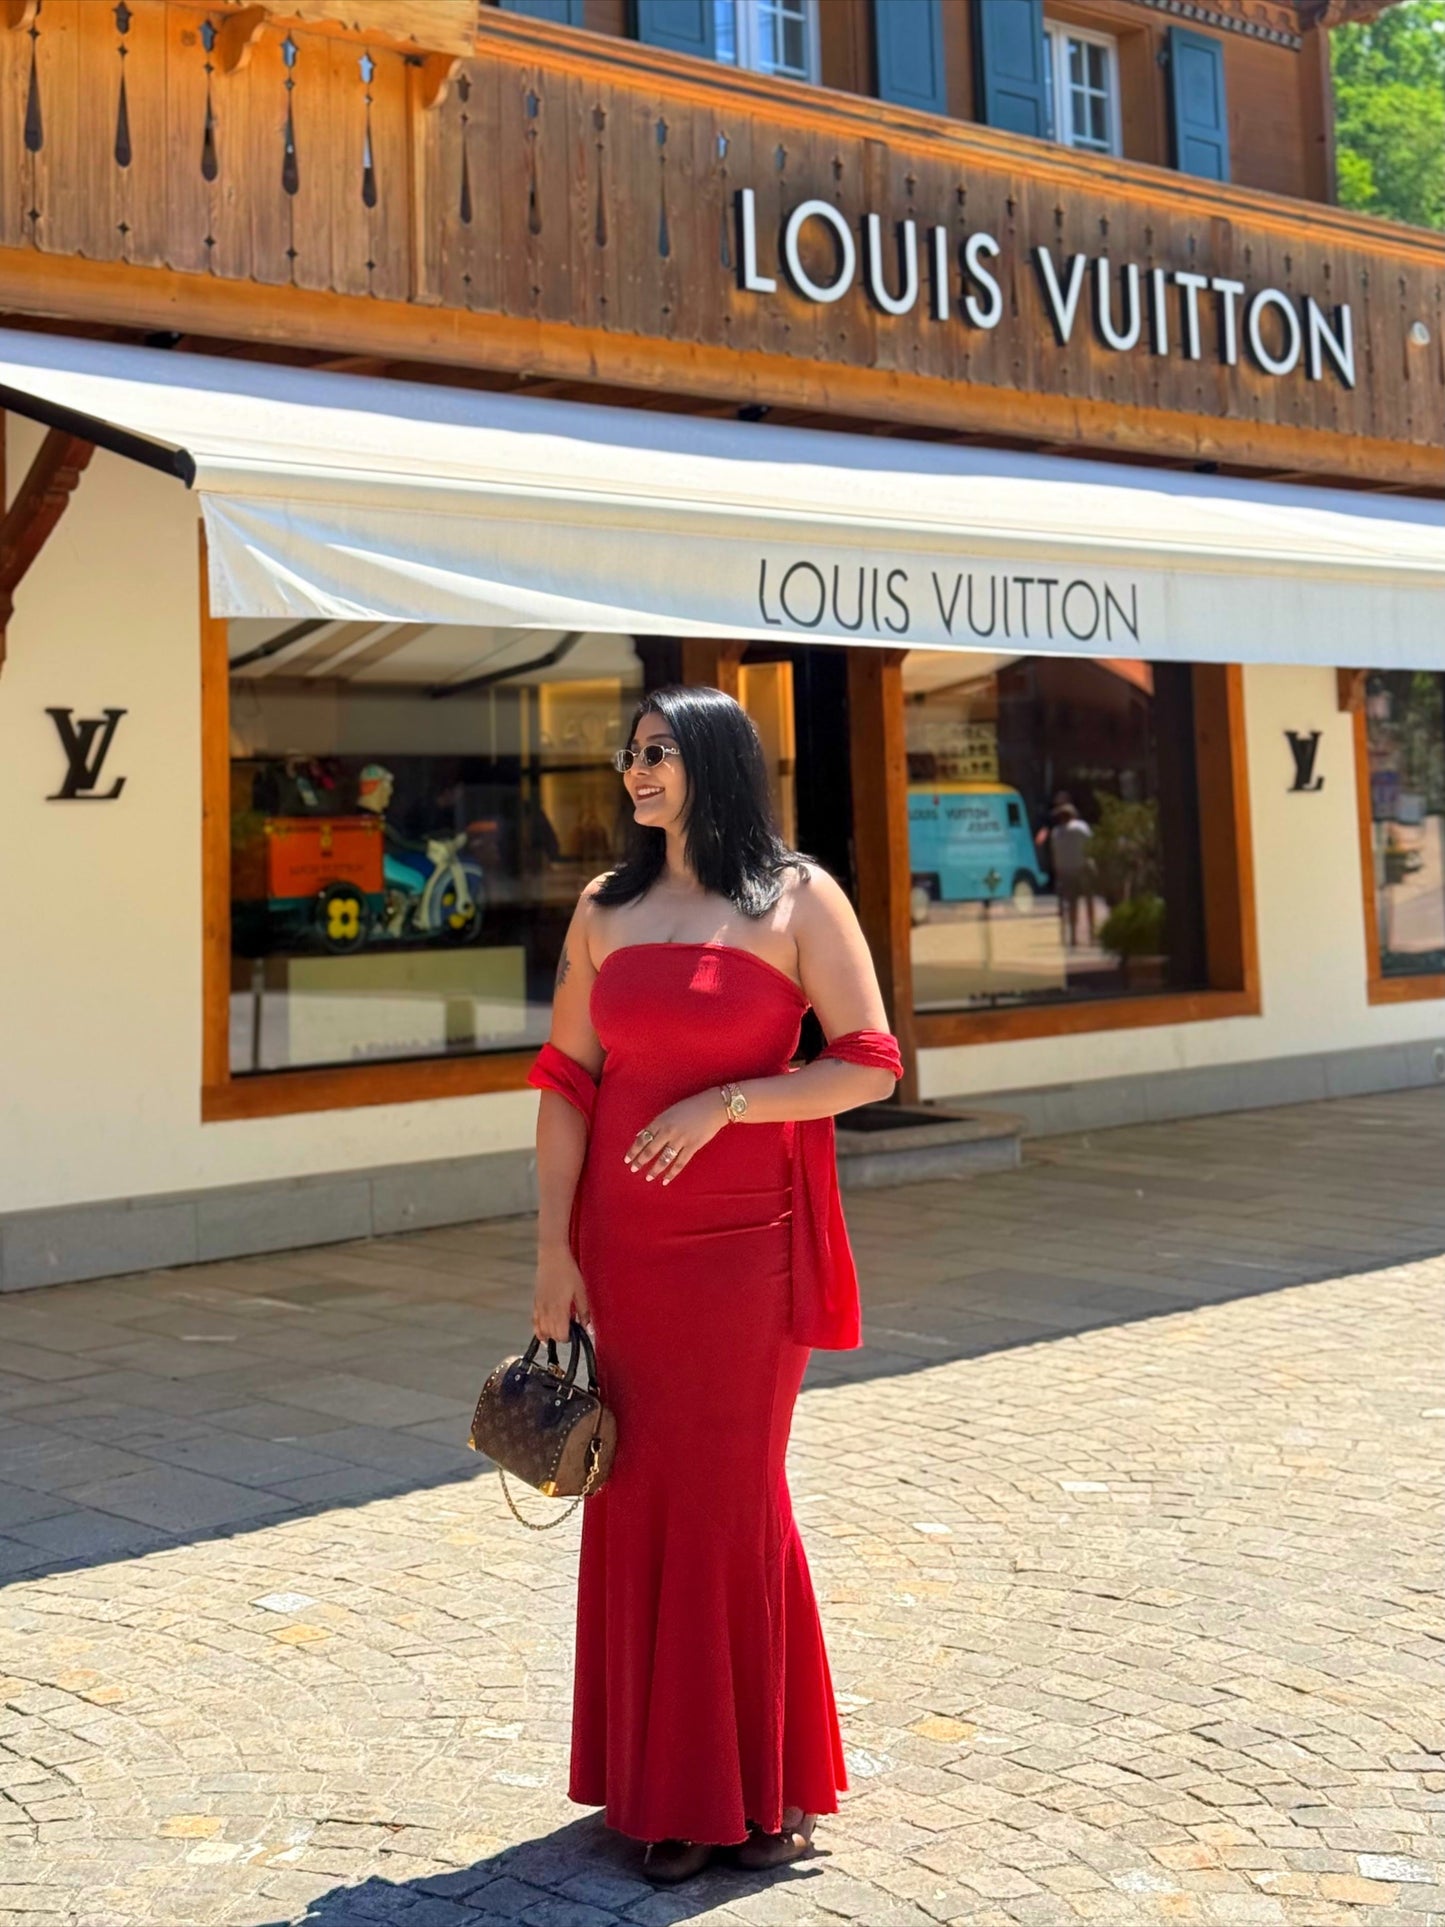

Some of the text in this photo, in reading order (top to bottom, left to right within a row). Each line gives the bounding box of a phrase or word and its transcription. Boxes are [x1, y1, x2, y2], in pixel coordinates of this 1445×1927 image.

[736, 188, 1355, 387] LOUIS VUITTON
[759, 558, 1140, 642] LOUIS VUITTON
[44, 707, 128, 802] LV
